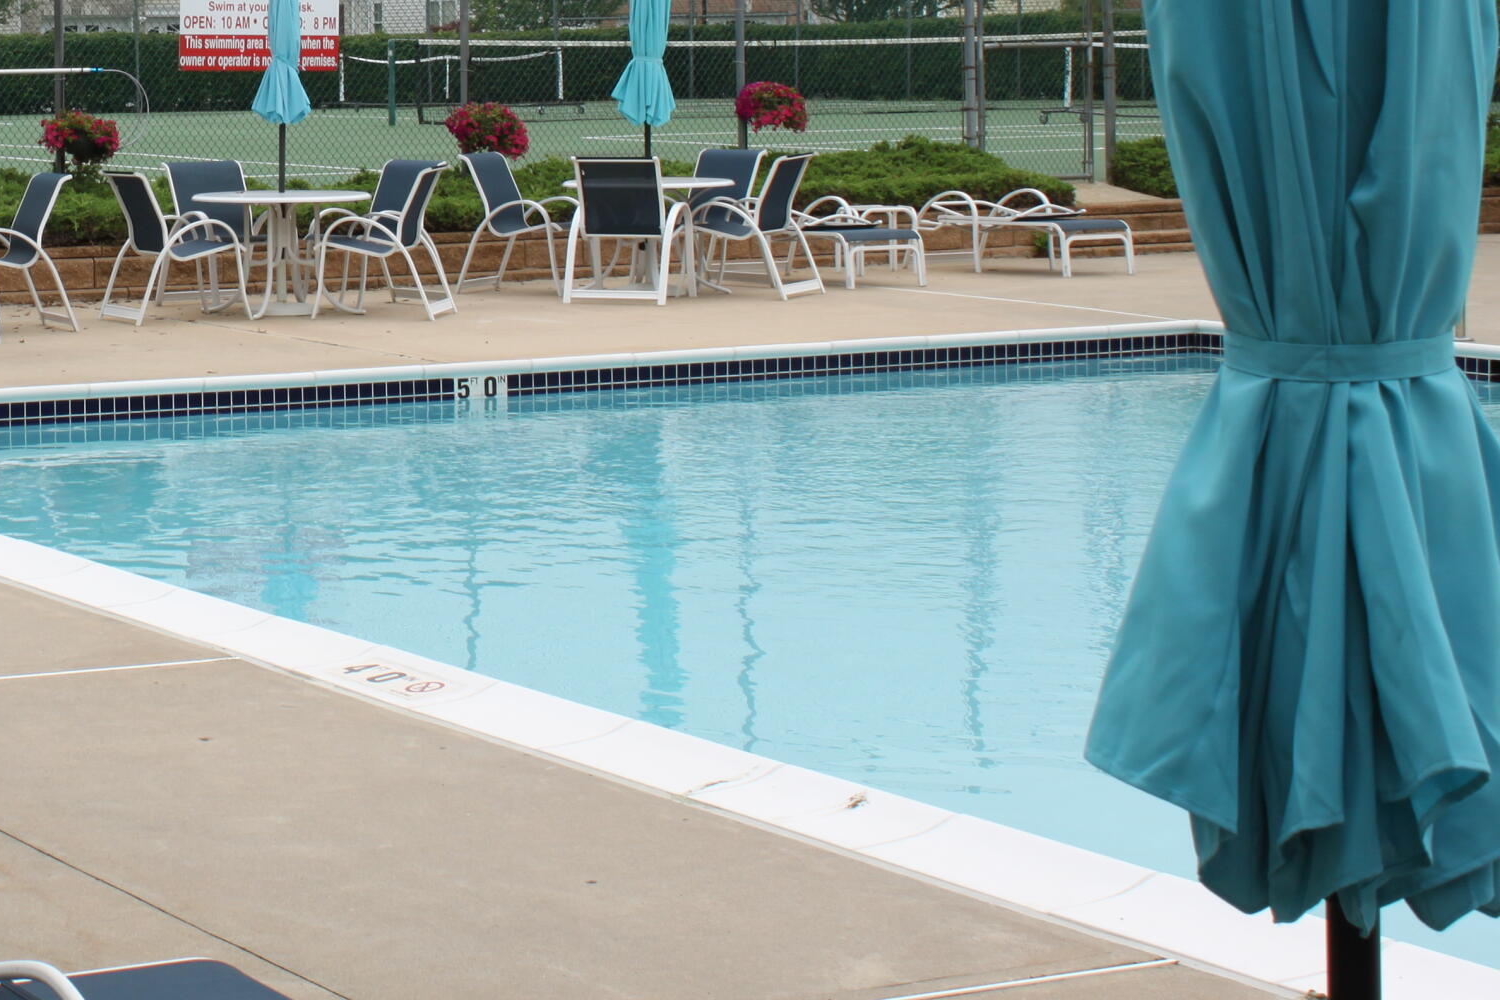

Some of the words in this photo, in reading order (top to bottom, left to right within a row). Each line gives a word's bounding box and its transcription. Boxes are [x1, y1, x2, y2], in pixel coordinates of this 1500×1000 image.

[208, 1, 235, 12] Swim
[237, 2, 246, 12] at
[299, 2, 315, 12] isk.
[183, 15, 216, 29] OPEN:
[221, 16, 232, 29] 10
[235, 16, 250, 29] AM
[313, 16, 319, 30] 8
[323, 16, 336, 30] PM
[184, 35, 203, 49] This
[204, 35, 245, 53] swimming
[246, 38, 264, 49] area
[301, 36, 321, 50] when
[322, 36, 334, 50] the
[180, 56, 206, 67] owner
[207, 56, 217, 67] or
[218, 53, 251, 70] operator
[253, 53, 261, 67] is
[261, 56, 273, 67] no
[301, 53, 337, 71] premises.
[457, 378, 470, 399] 5
[484, 376, 497, 397] 0
[343, 663, 380, 674] 4
